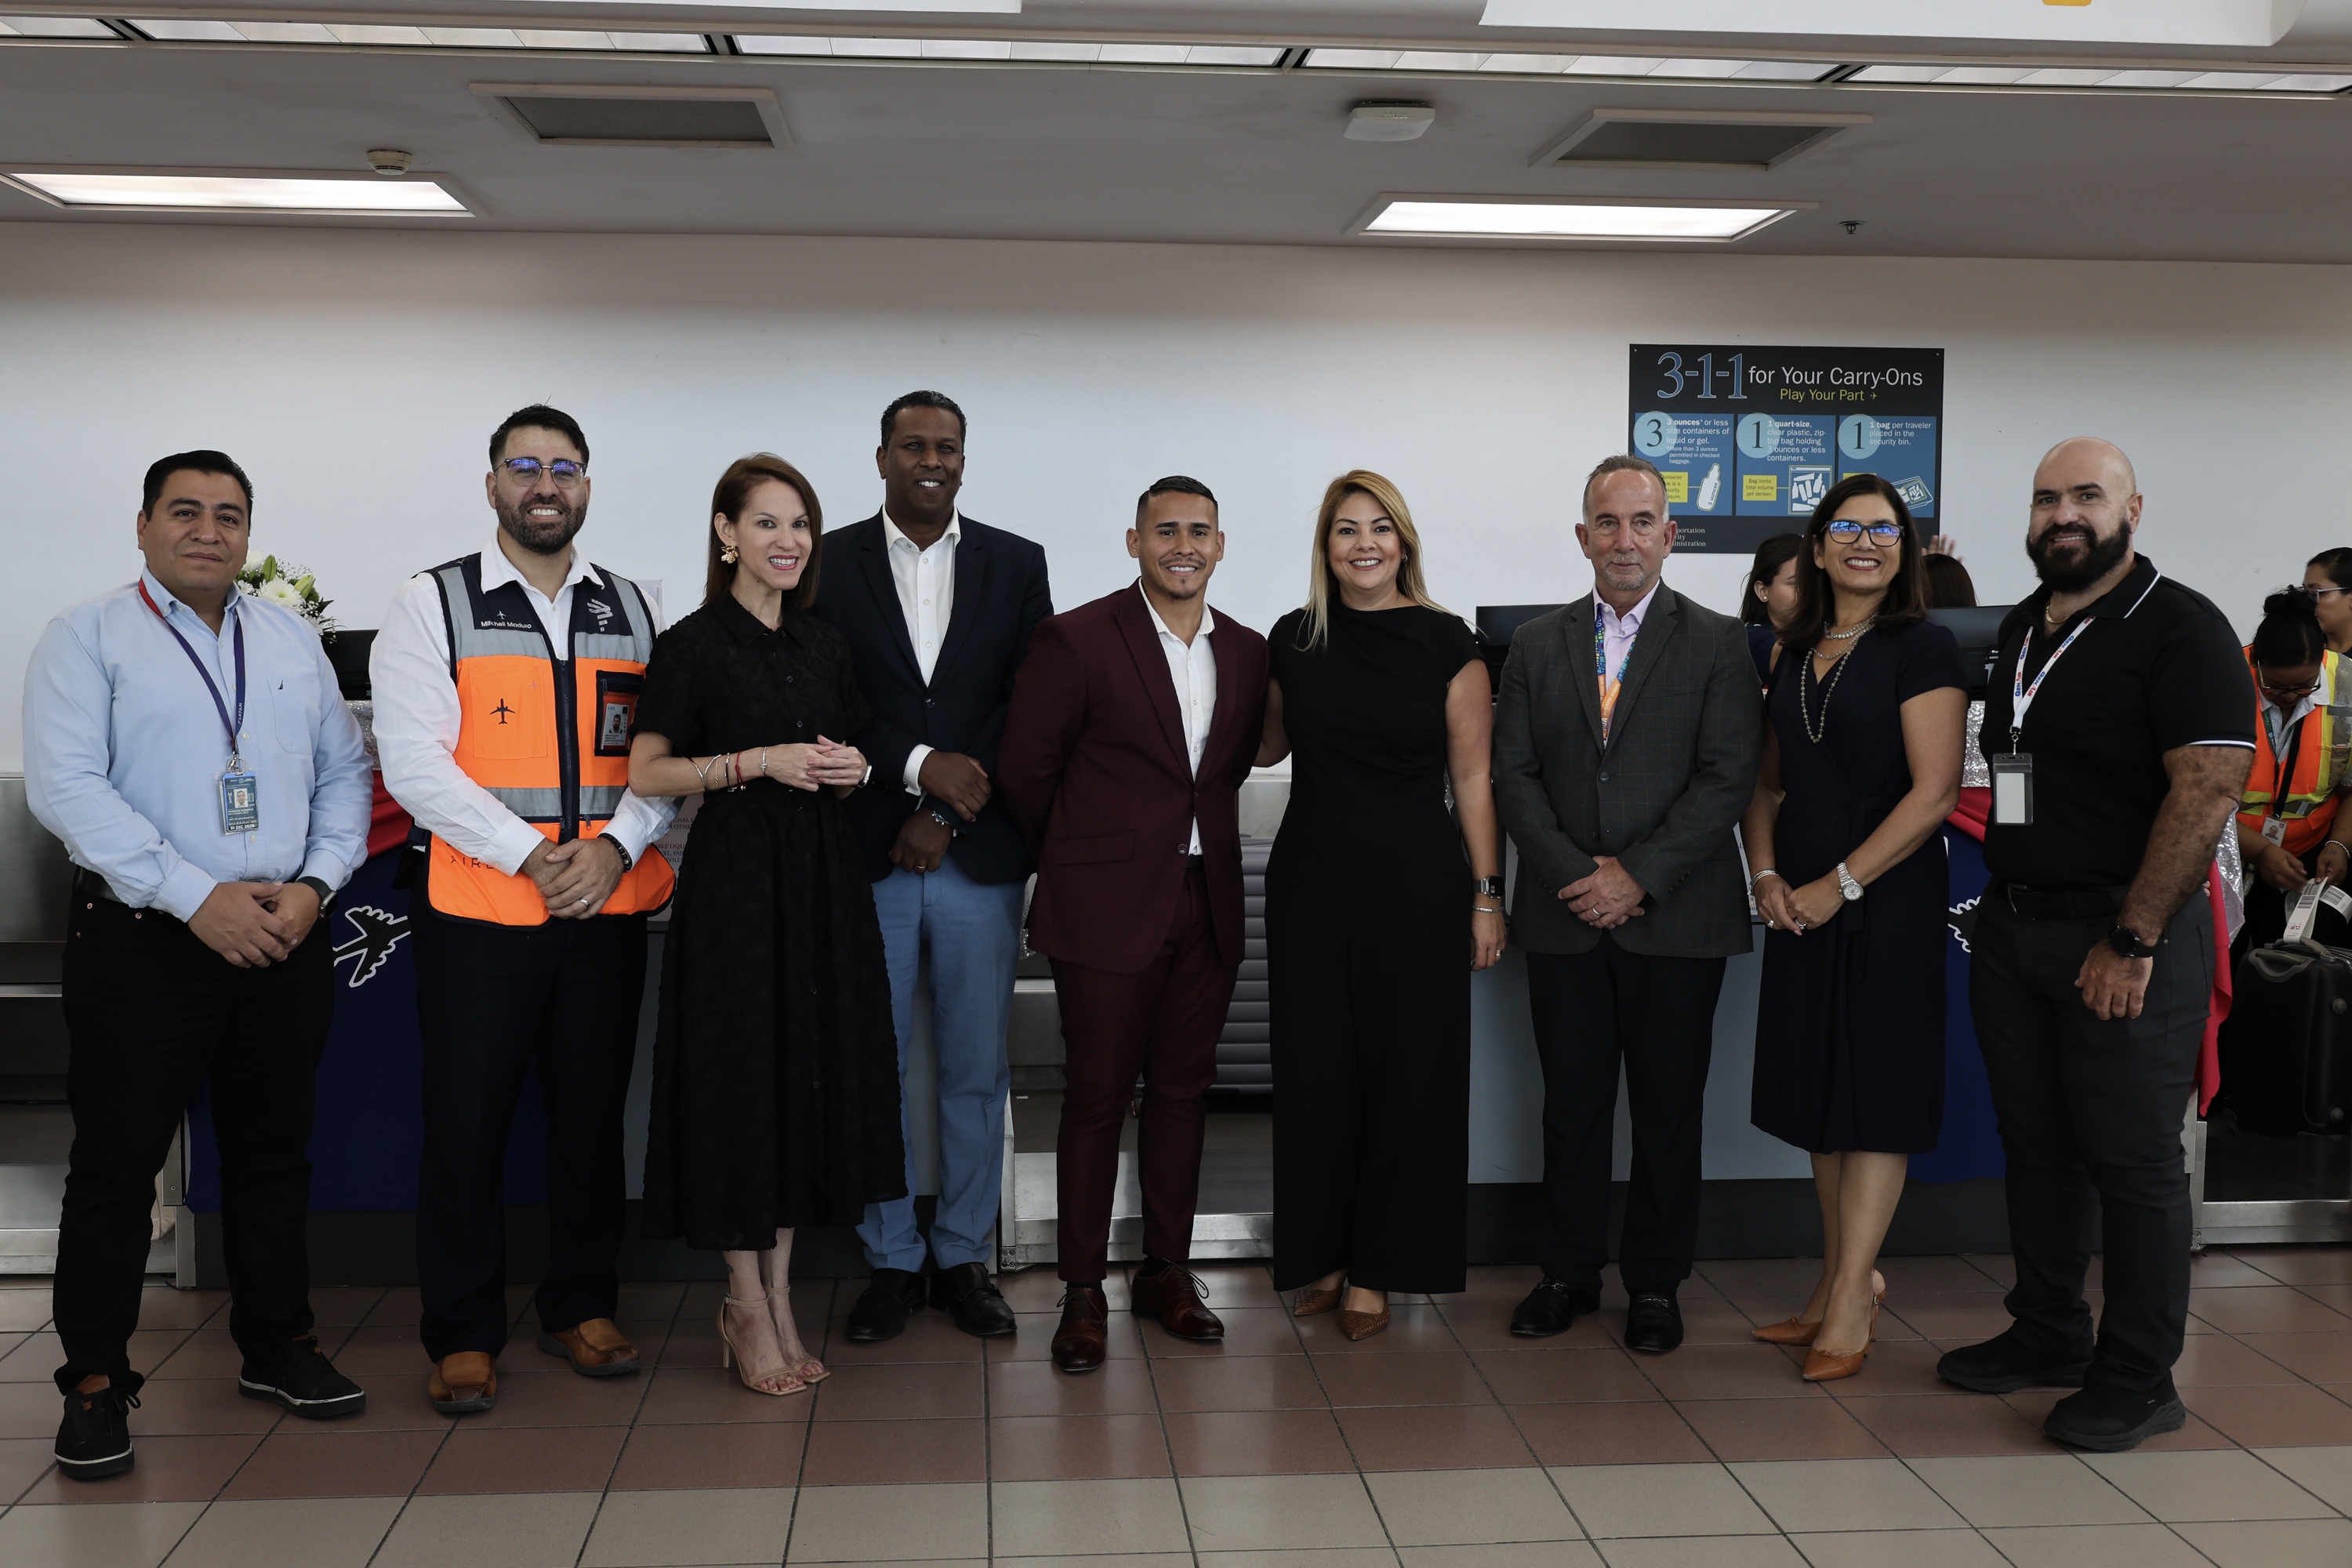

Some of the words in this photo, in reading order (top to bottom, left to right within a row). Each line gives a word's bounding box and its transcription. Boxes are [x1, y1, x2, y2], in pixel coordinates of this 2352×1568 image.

[1657, 352, 1747, 399] 3-1-1
[1748, 366, 1775, 383] for
[1781, 367, 1824, 384] Your
[1830, 367, 1922, 389] Carry-Ons
[1780, 389, 1805, 402] Play
[1809, 389, 1835, 400] Your
[1839, 390, 1864, 400] Part
[1647, 419, 1662, 447] 3
[1752, 421, 1763, 448] 1
[1853, 422, 1864, 449] 1
